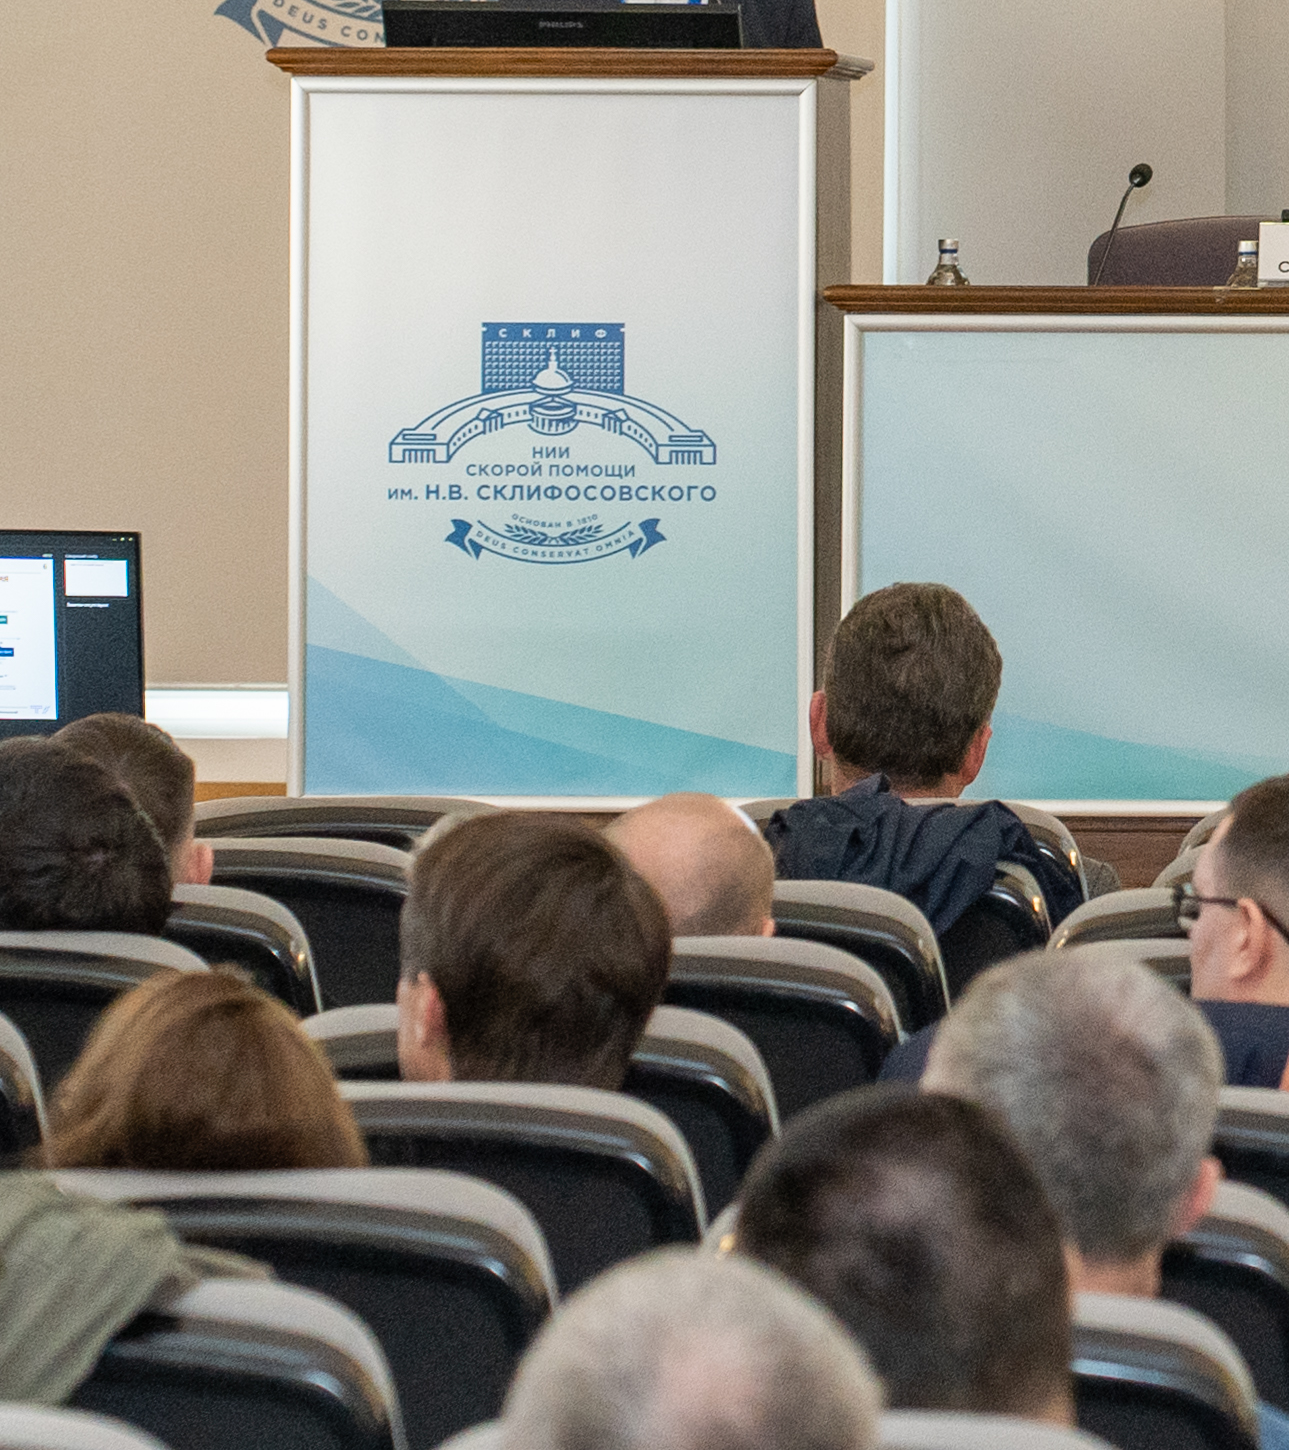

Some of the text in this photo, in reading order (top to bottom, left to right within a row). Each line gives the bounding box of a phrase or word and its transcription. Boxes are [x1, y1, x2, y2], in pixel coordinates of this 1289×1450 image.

[498, 327, 608, 339] СКЛИФ
[532, 446, 570, 459] НИИ
[465, 462, 636, 480] СКОРОЙ ПОМОЩИ
[388, 484, 717, 503] им. Н.В. СКЛИФОСОВСКОГО
